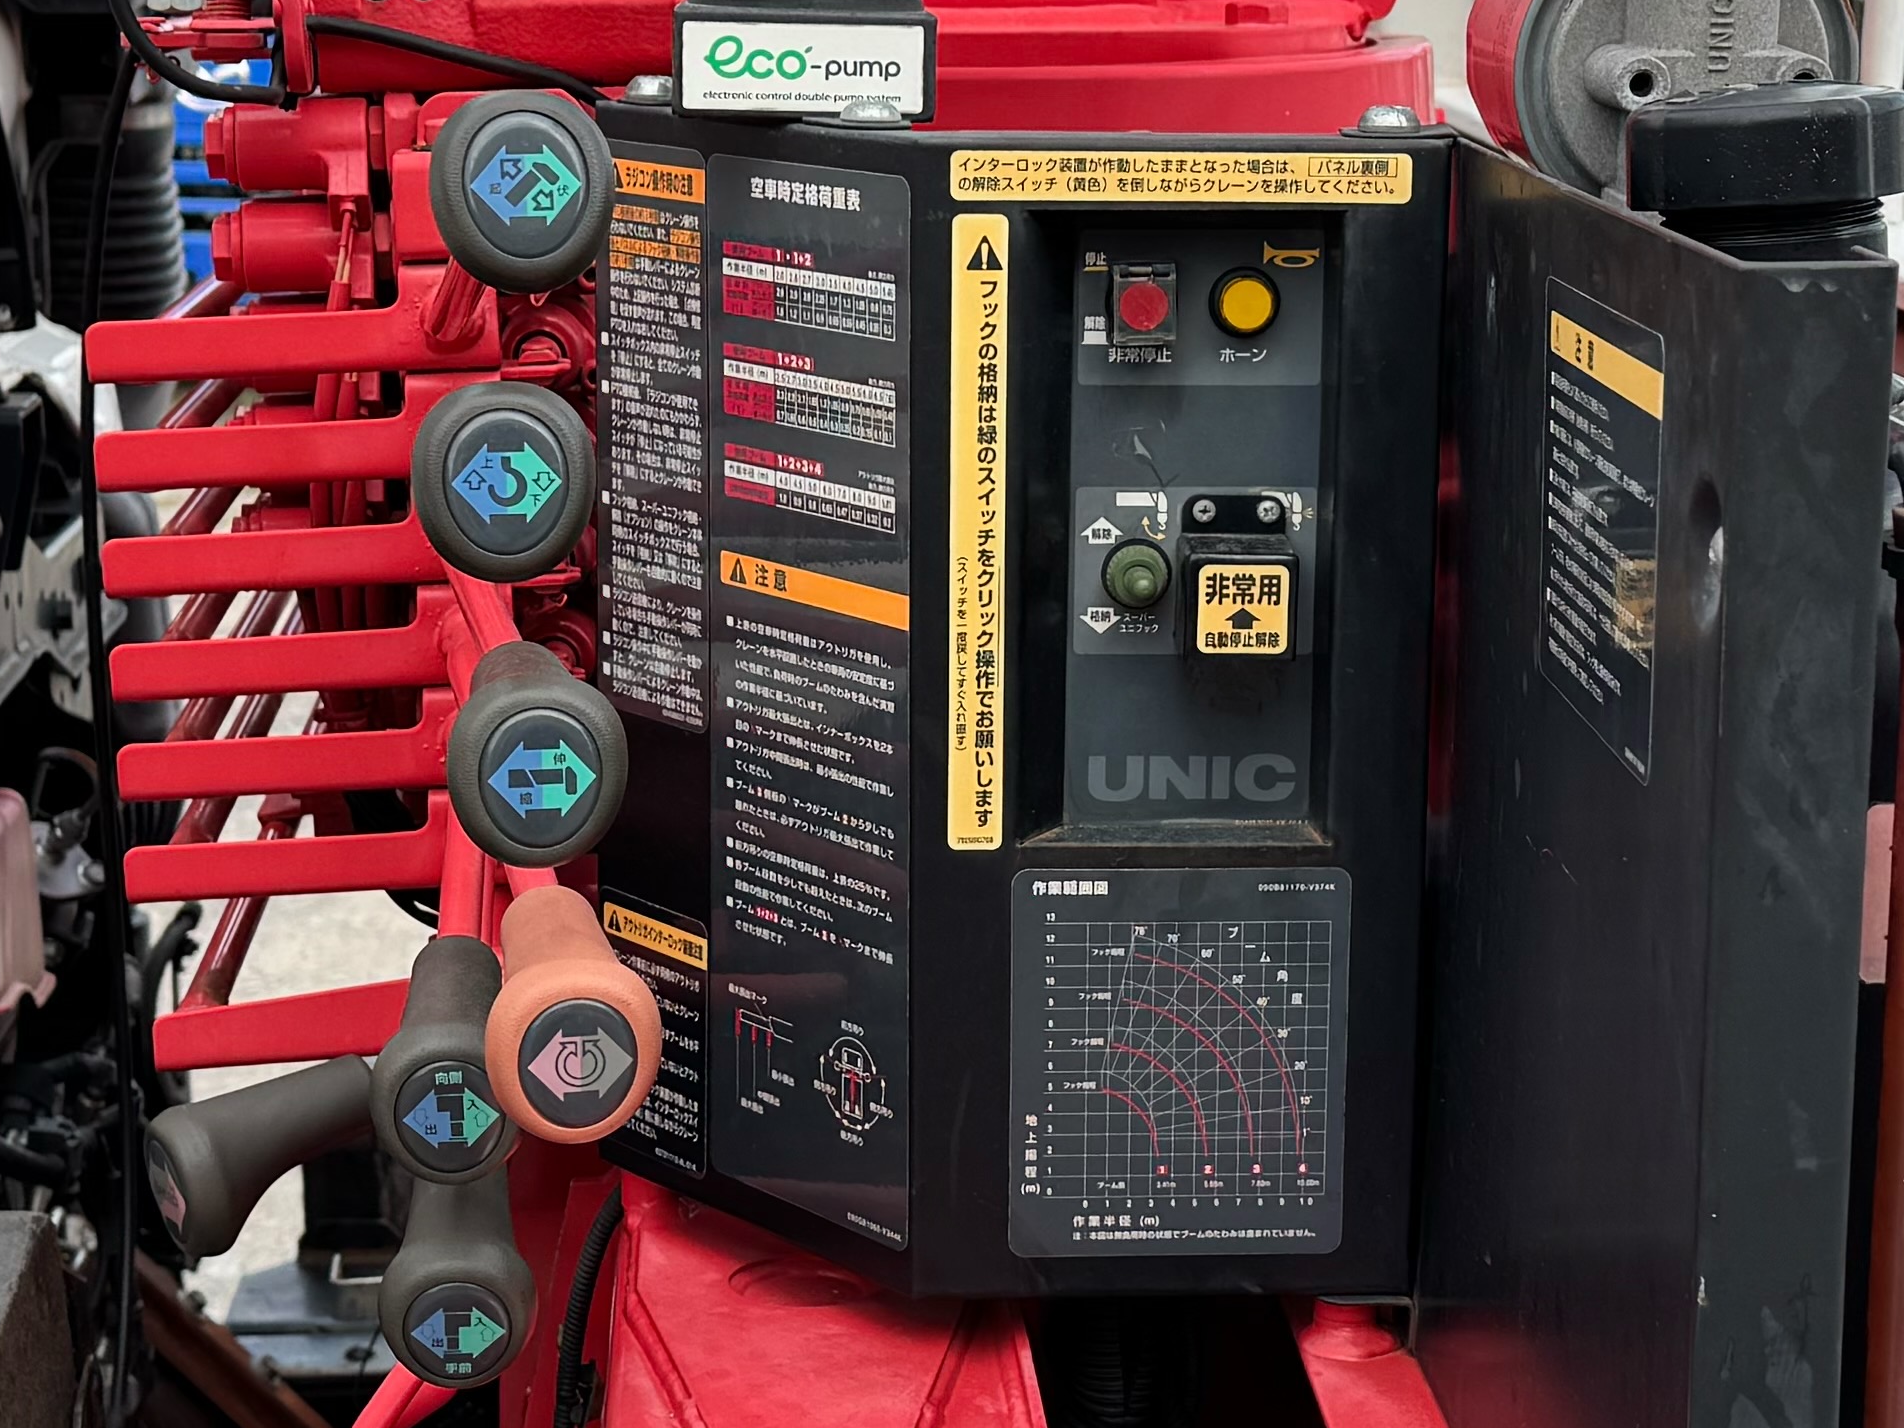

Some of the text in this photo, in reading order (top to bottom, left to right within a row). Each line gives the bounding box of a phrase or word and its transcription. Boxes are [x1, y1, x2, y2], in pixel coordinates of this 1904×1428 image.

[704, 35, 901, 81] eco-pump
[703, 90, 752, 100] electronic
[756, 91, 792, 100] control
[795, 93, 831, 102] double
[958, 157, 1389, 175] インターロック装置が作動したままとなった場合は、 パネル裏側
[958, 177, 1397, 194] の解除スイッチ（黄色）を倒しながらクレーンを操作してください。
[751, 177, 861, 211] 空車時定格荷重表
[1085, 252, 1107, 266] 停止
[1084, 316, 1106, 330] 解除
[1108, 347, 1172, 363] 非常停止
[1220, 348, 1267, 363] ホーン
[480, 456, 494, 469] 上
[529, 494, 542, 507] 下
[974, 280, 999, 828] フックの格納は緑のスイッチをクリック操作でお願いします
[755, 563, 787, 592] 注意
[1205, 573, 1281, 606] 非常用
[1123, 613, 1156, 622] スーパー
[1119, 624, 1159, 633] ユニフック
[1205, 632, 1280, 649] 自動停止解除
[1088, 753, 1296, 802] UNIC
[466, 1099, 480, 1110] 入
[425, 1124, 437, 1135] 出
